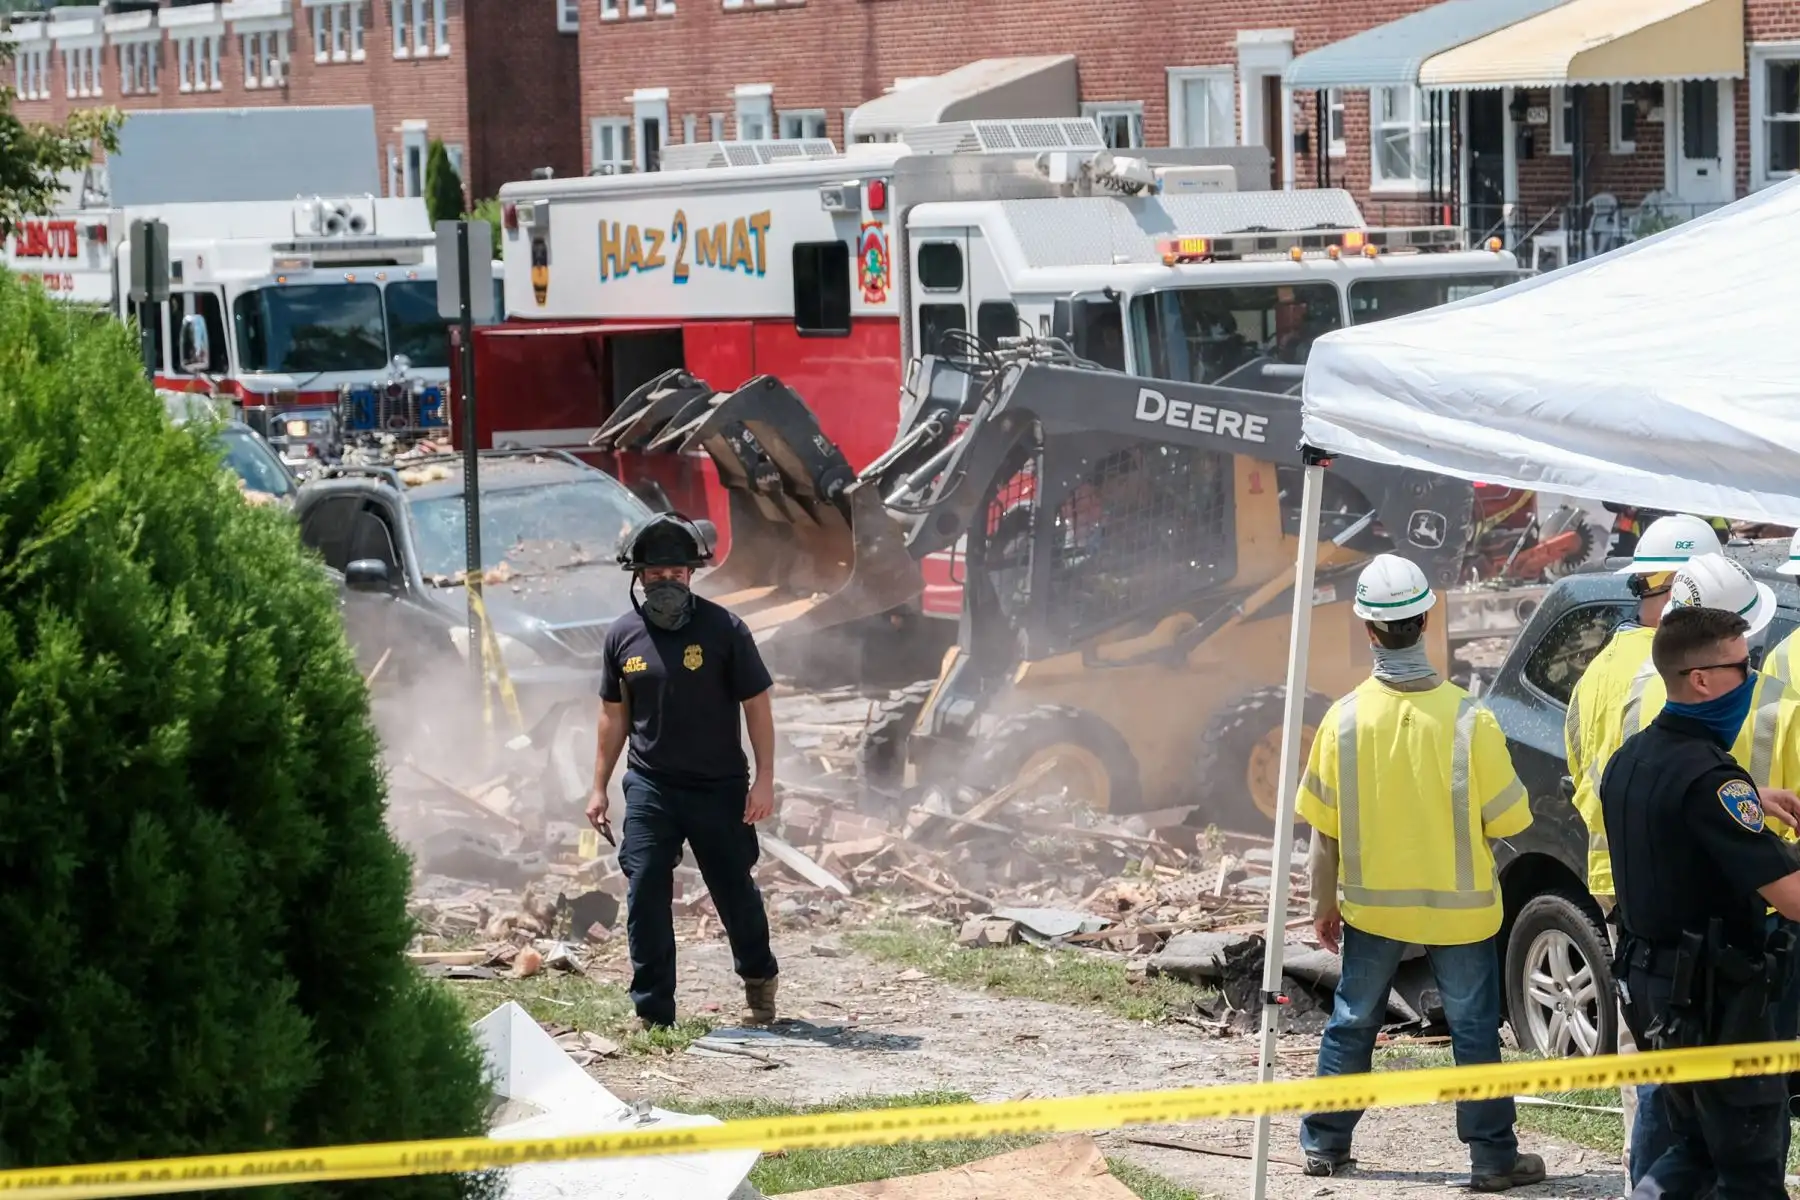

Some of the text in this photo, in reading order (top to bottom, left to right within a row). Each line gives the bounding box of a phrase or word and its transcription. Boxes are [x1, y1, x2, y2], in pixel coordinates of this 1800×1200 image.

[598, 208, 771, 285] HAZ 2 MAT
[1135, 387, 1269, 443] DEERE
[1674, 540, 1695, 550] BGE
